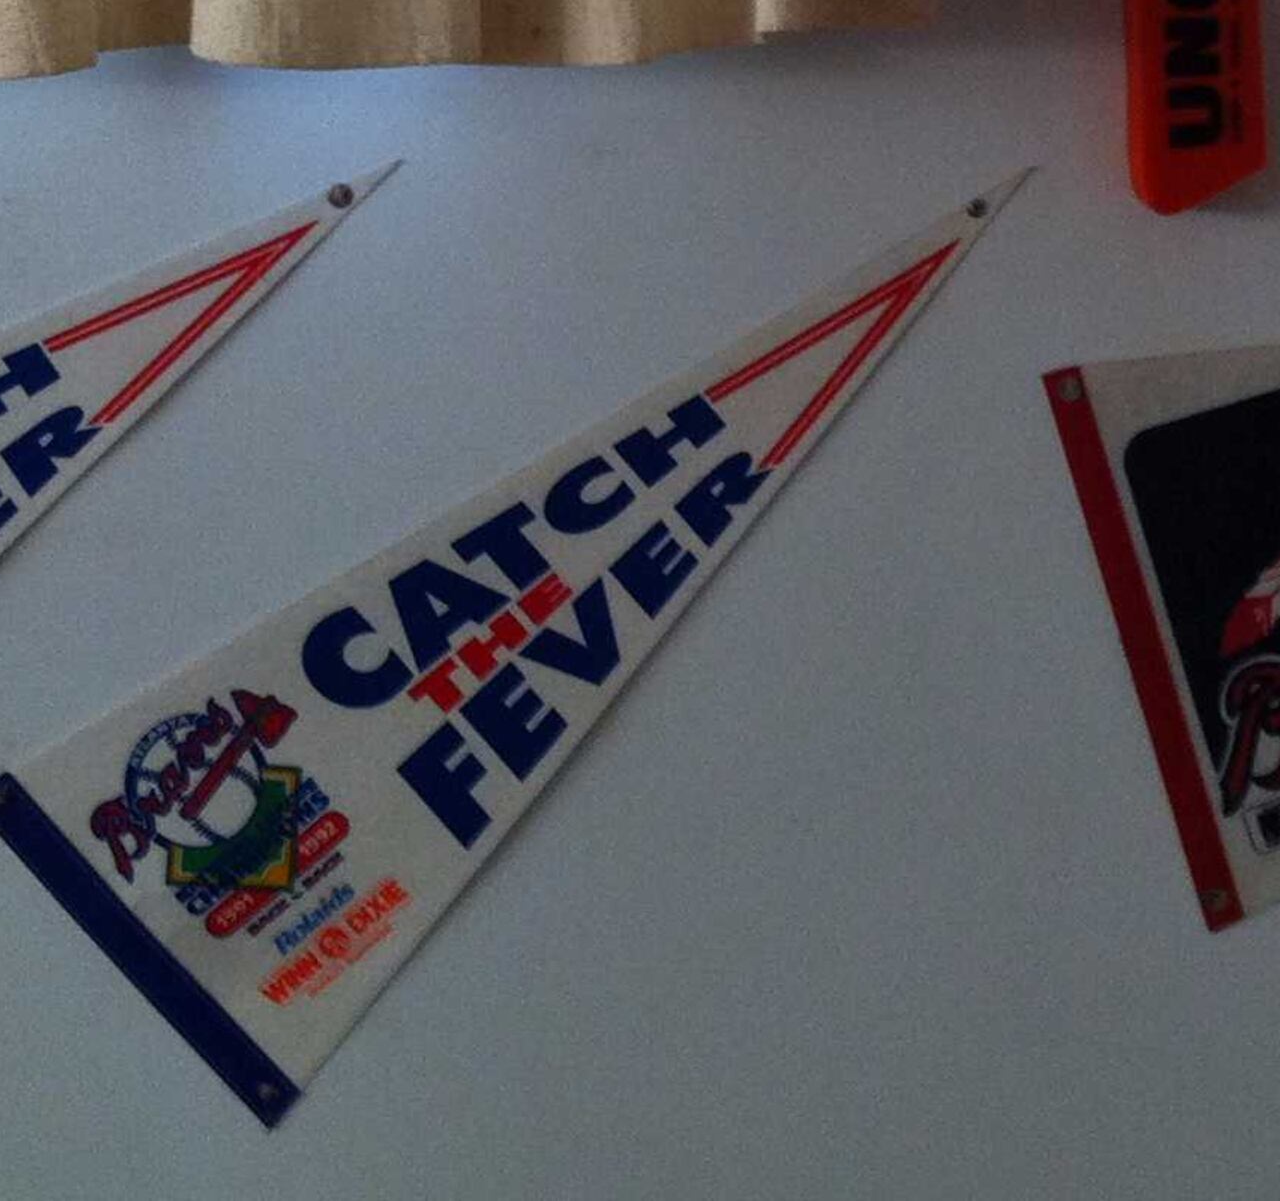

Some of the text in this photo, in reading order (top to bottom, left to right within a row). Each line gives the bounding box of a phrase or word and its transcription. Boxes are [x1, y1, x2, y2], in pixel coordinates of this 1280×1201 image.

[301, 391, 725, 708] CATCH
[396, 451, 772, 851] FEVER
[407, 572, 574, 713] THE
[90, 696, 234, 884] Braves
